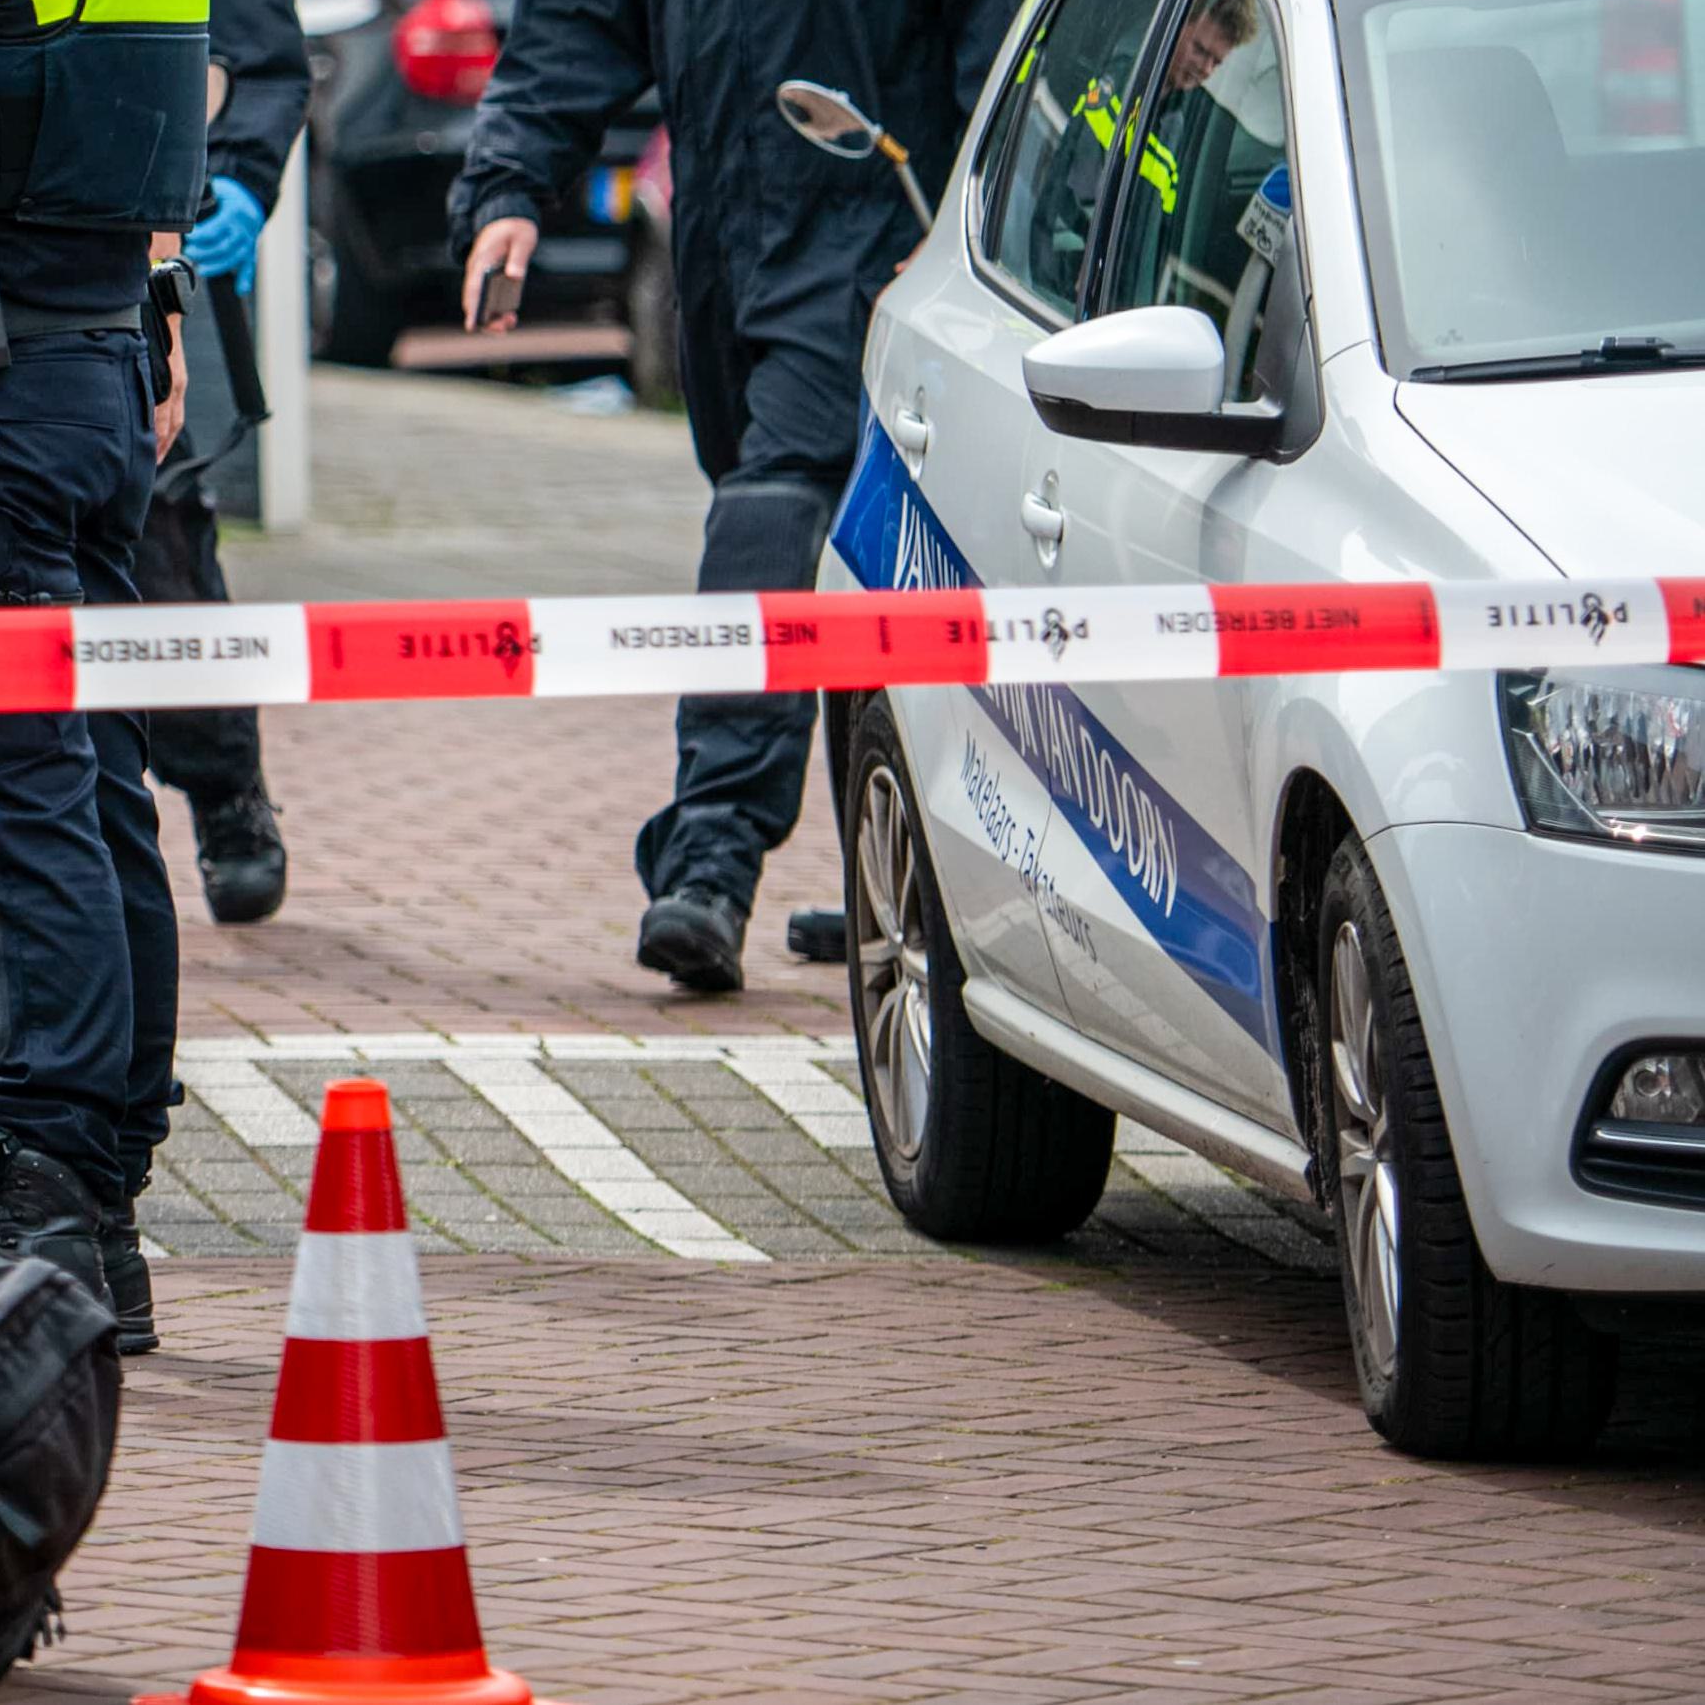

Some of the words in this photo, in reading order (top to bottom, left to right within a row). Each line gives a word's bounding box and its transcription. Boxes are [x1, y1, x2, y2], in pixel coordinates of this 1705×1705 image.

[1487, 592, 1627, 628] POLITIE
[1156, 612, 1290, 635] BETREDEN
[208, 637, 270, 658] NIET
[610, 625, 751, 650] BETREDEN
[60, 638, 202, 664] BETREDEN
[1080, 726, 1179, 919] DOORN
[960, 728, 1016, 862] Makelaars
[1019, 827, 1098, 963] Taxateurs
